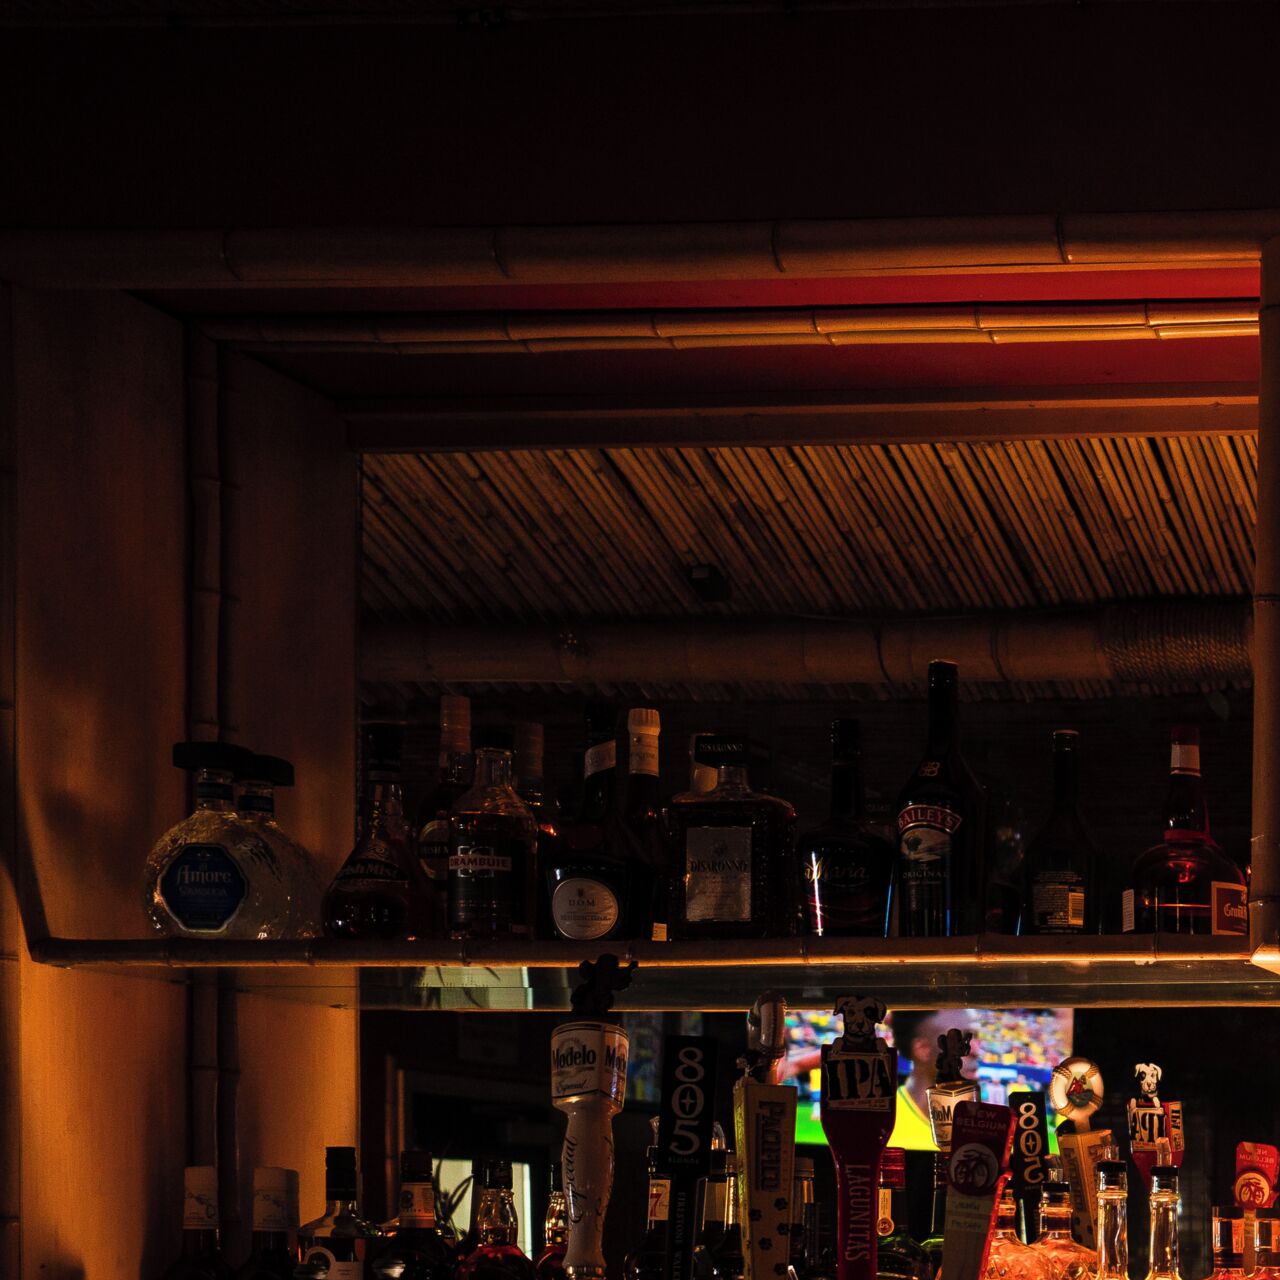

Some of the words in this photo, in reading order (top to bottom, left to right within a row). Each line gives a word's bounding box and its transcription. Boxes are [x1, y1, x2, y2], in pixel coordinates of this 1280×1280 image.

[690, 860, 748, 873] DISARONNO
[824, 1057, 895, 1101] IPA
[666, 1046, 708, 1157] 805
[955, 1117, 1008, 1132] BELGIUM
[650, 1190, 663, 1219] 7
[844, 1163, 871, 1262] LAGUNITAS
